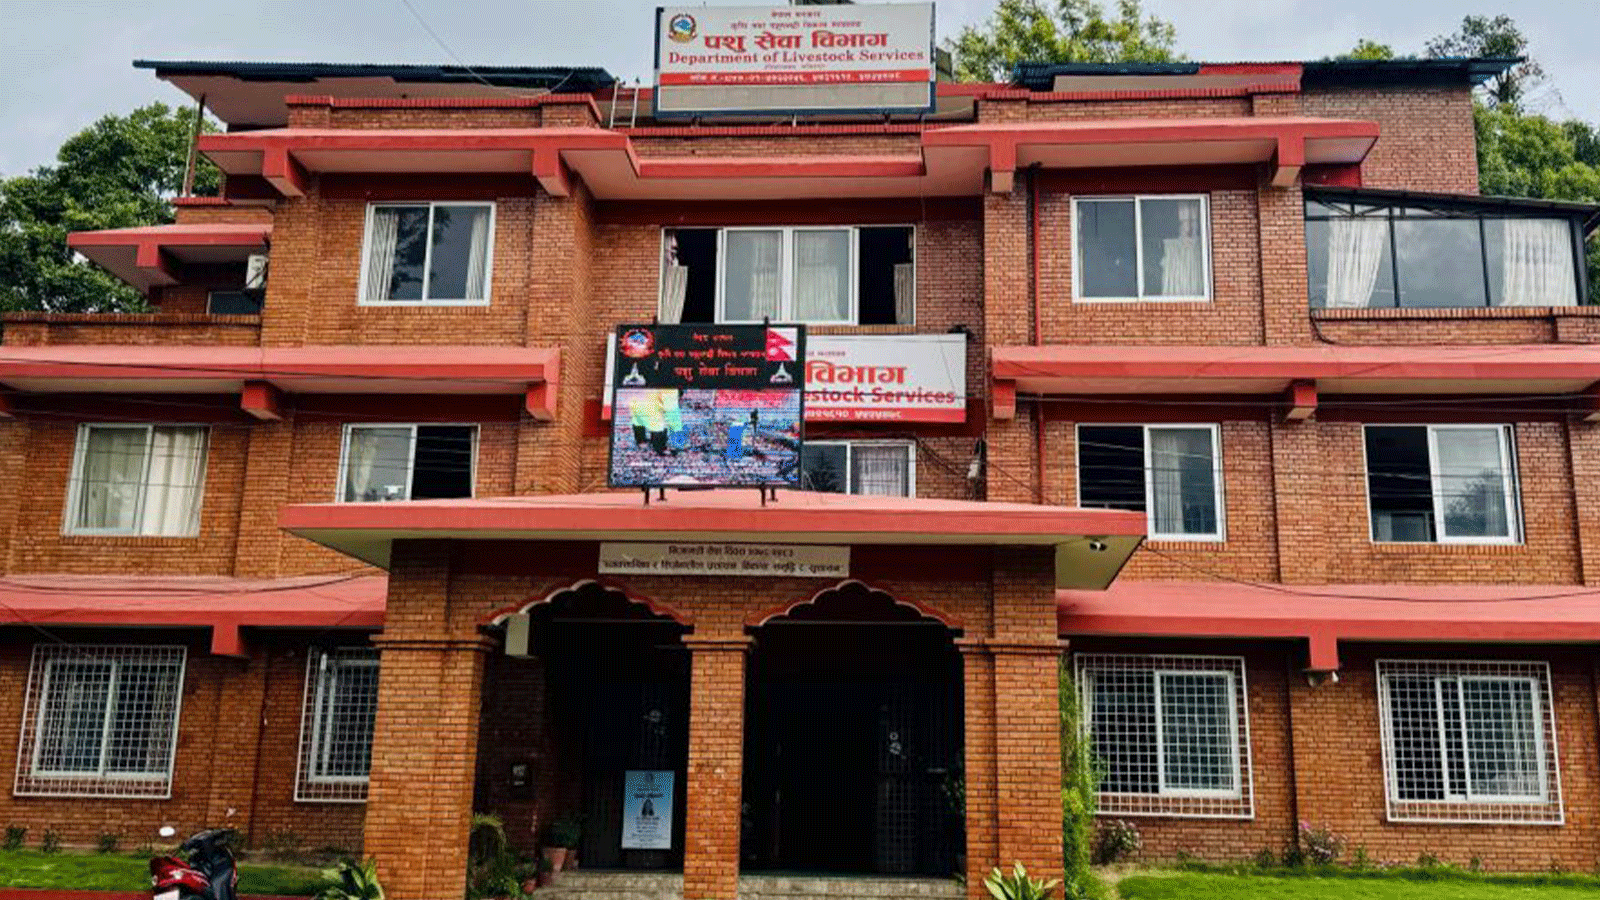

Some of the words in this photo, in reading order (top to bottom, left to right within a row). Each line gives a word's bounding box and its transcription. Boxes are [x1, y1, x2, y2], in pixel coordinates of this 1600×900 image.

[704, 34, 747, 53] पशु
[754, 31, 802, 50] सेवा
[811, 30, 889, 48] विभाग
[668, 51, 758, 65] Department
[763, 51, 779, 63] of
[783, 50, 855, 63] Livestock
[859, 49, 924, 62] Services
[806, 359, 907, 384] विभाग
[805, 387, 864, 403] stock
[871, 386, 955, 404] Services
